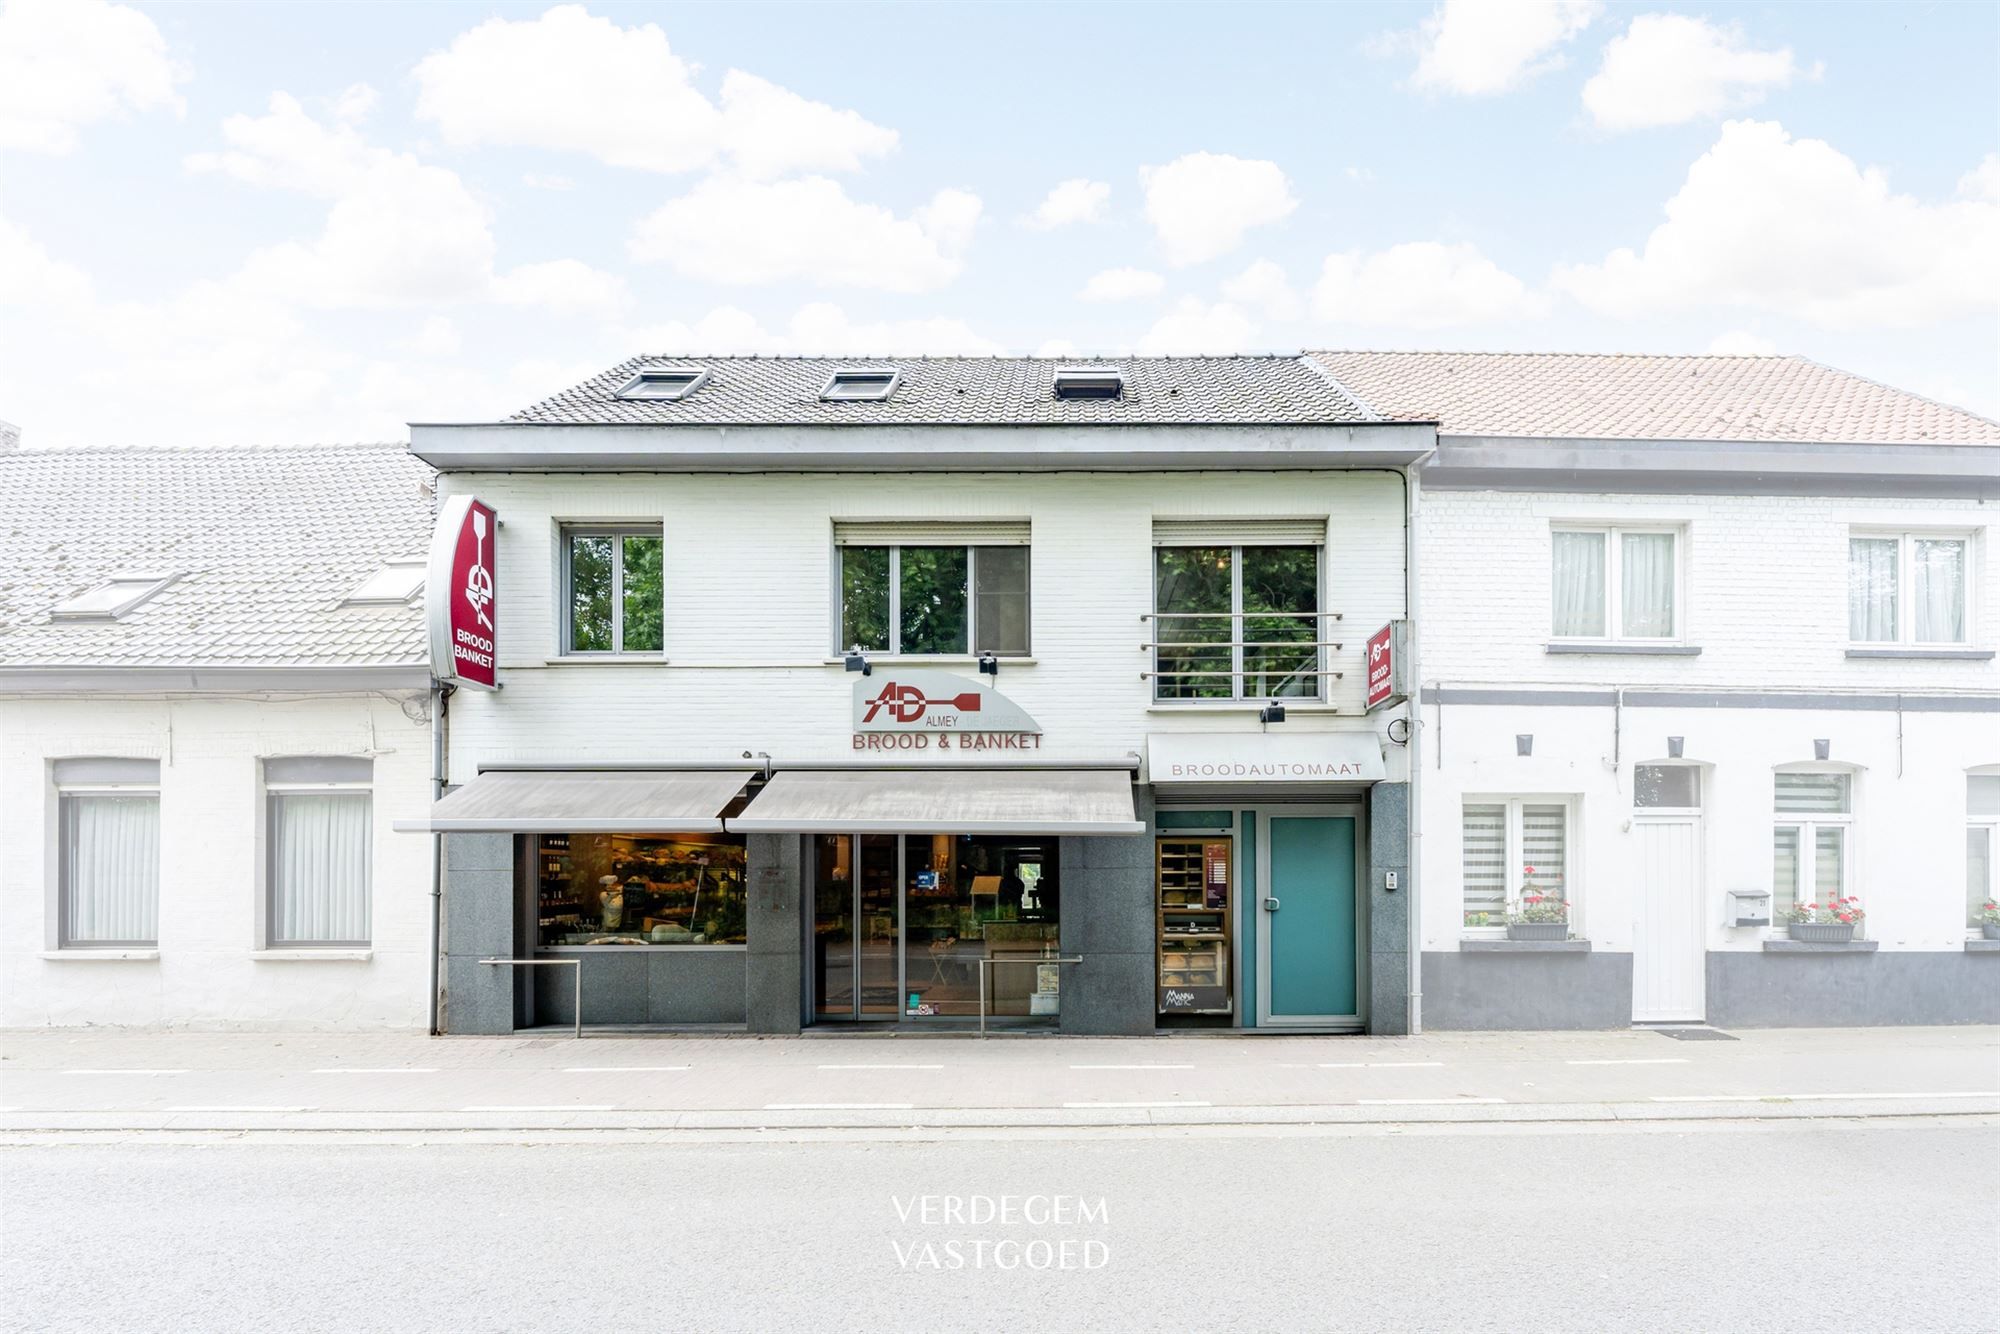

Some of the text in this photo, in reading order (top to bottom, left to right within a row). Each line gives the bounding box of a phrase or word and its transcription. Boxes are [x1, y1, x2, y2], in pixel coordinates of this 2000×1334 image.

[457, 628, 493, 653] BROOD
[454, 643, 494, 669] BANKET
[862, 682, 926, 722] AD
[926, 715, 959, 727] ALMEY
[853, 733, 1043, 750] BROOD & BANKET
[1172, 764, 1362, 775] BROODAUTOMAAT
